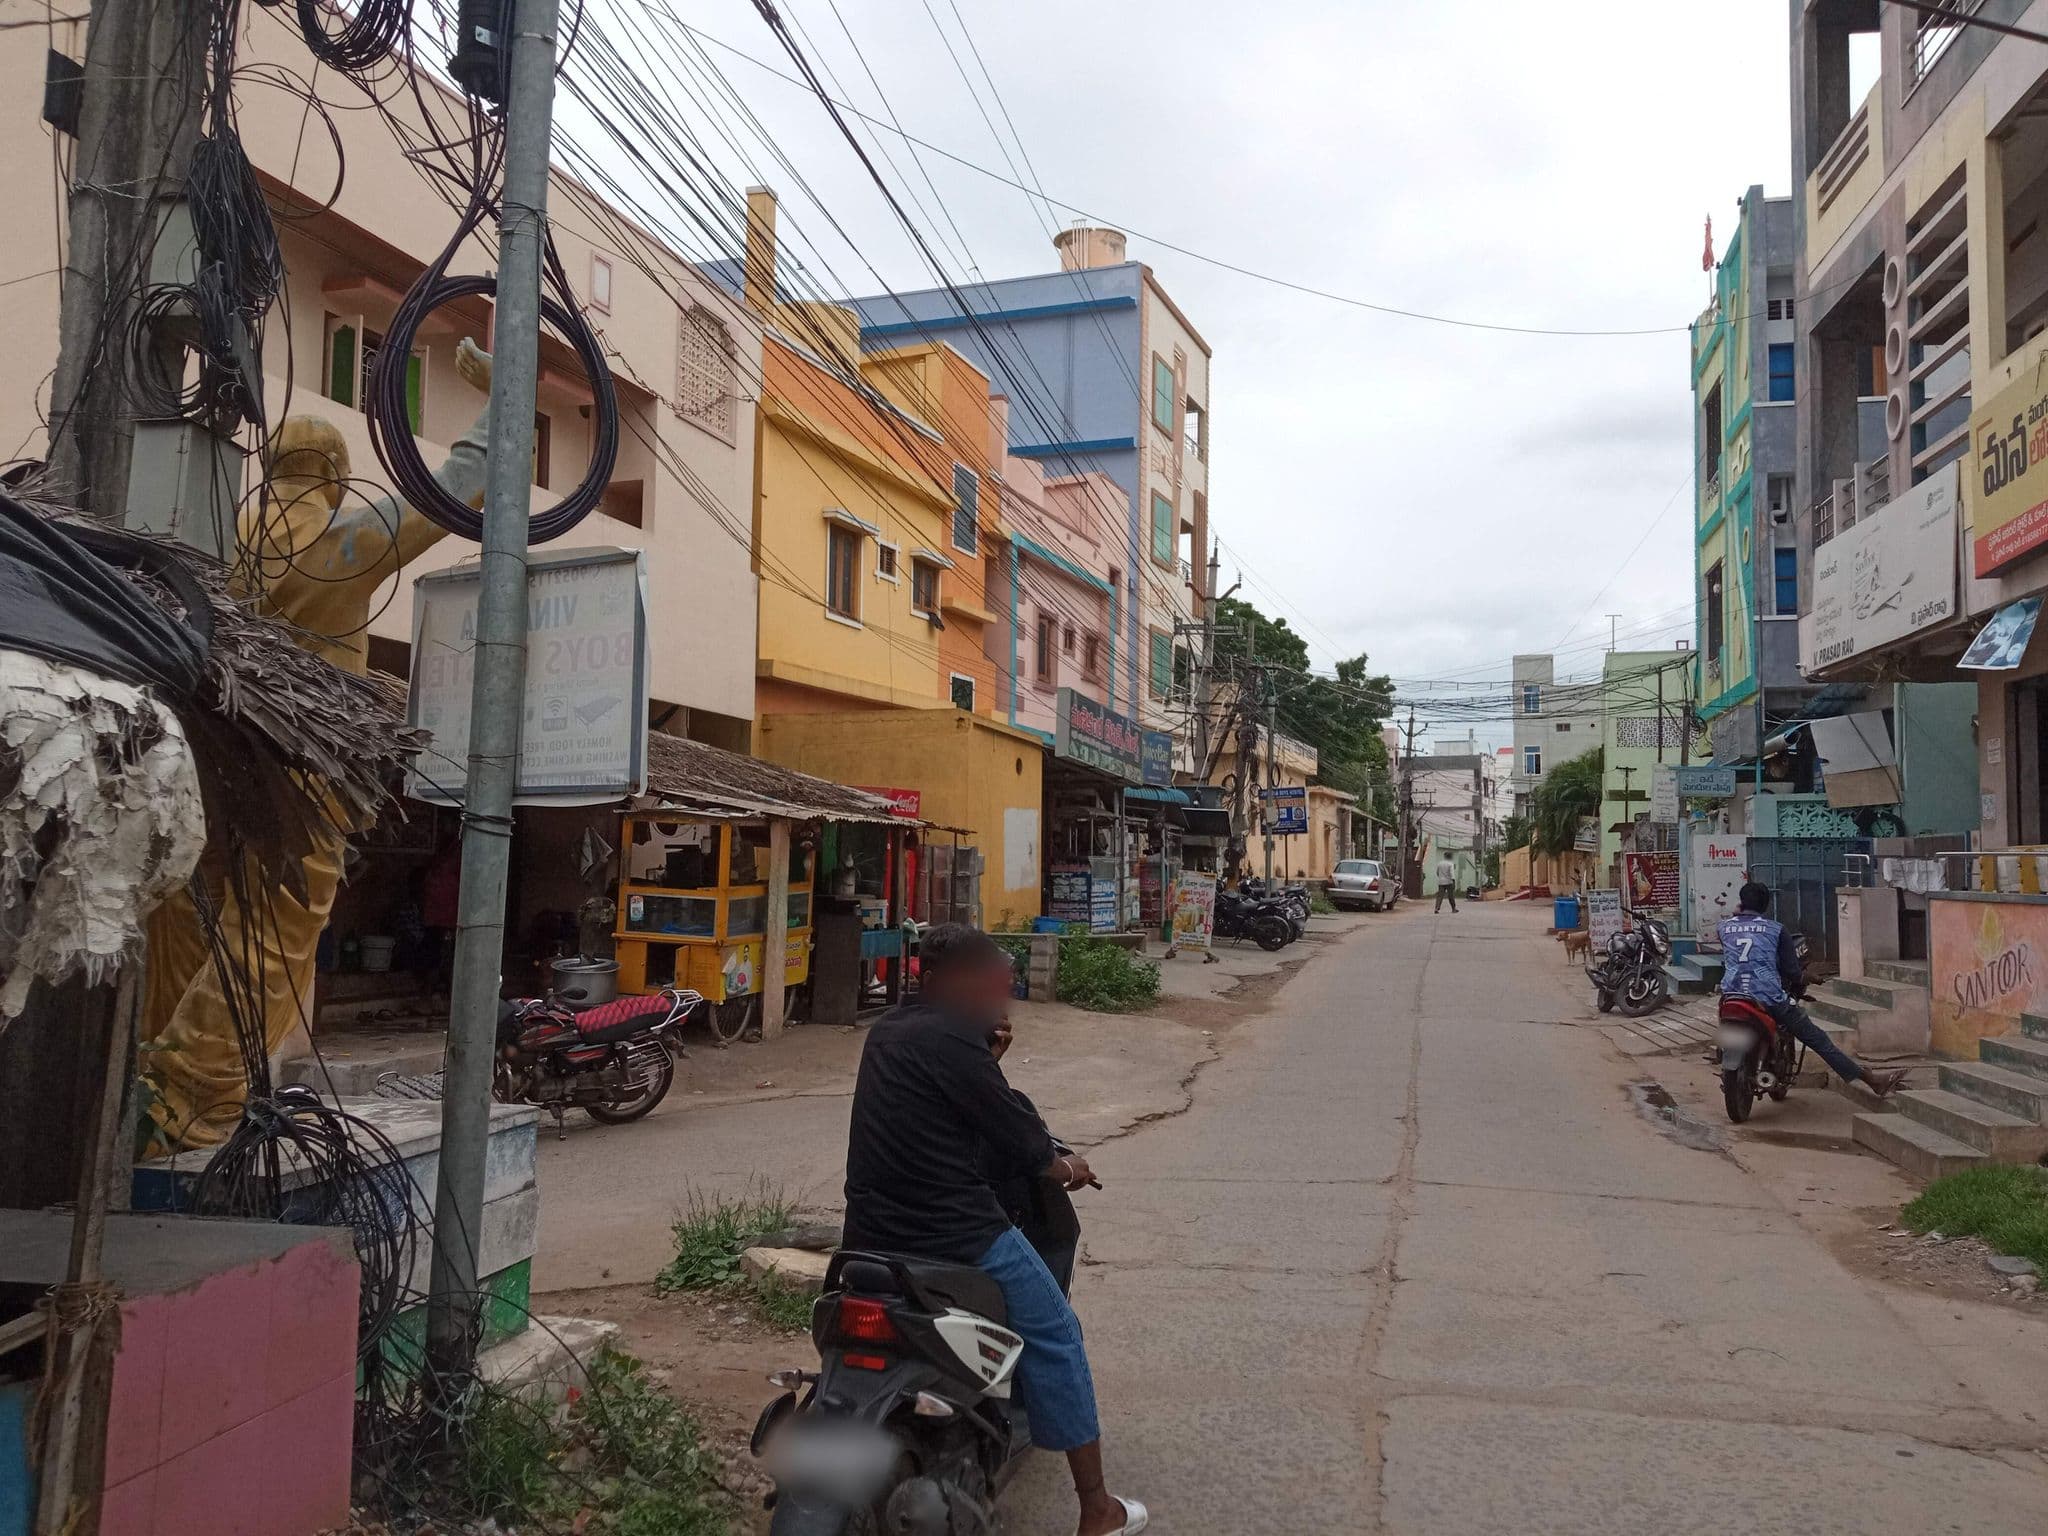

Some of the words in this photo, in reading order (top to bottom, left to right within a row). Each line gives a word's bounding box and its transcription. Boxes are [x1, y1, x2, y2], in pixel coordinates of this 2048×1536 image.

[1983, 413, 2028, 497] మన
[1819, 642, 1841, 665] PRASAD
[1842, 637, 1854, 657] RAO
[1709, 844, 1737, 860] Arun
[1725, 925, 1766, 934] KRANTHI
[1736, 938, 1753, 962] 7
[1952, 944, 2032, 1021] SANTOOR
